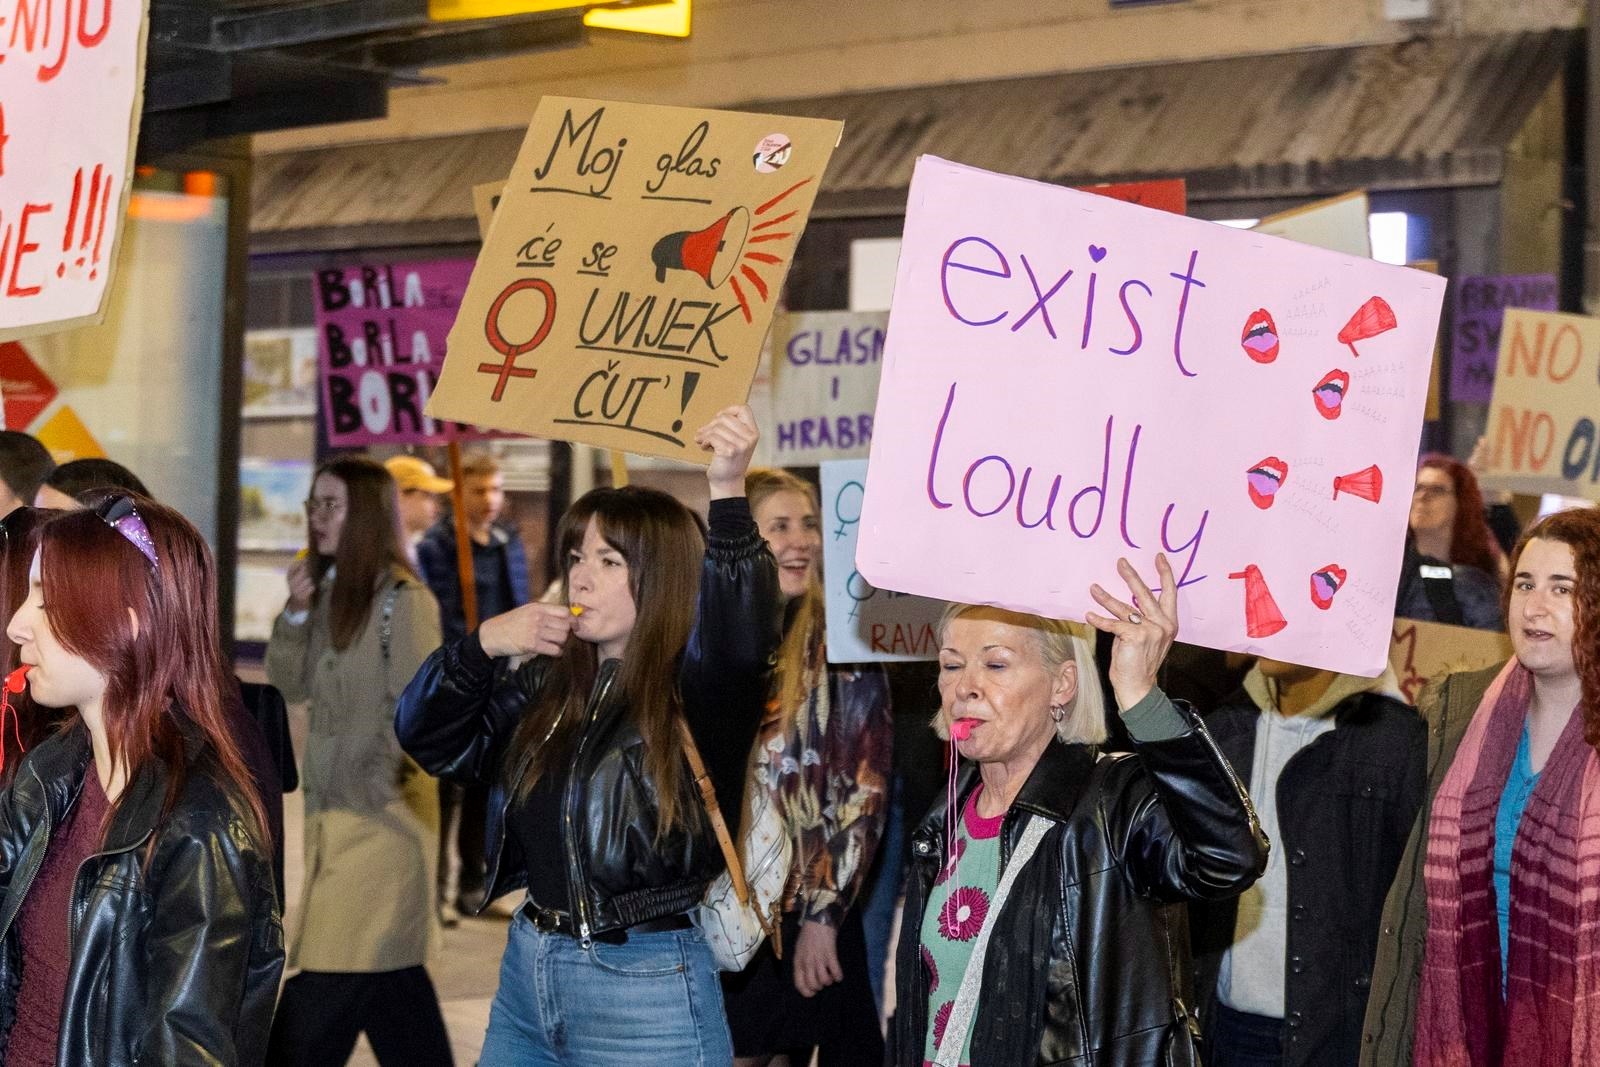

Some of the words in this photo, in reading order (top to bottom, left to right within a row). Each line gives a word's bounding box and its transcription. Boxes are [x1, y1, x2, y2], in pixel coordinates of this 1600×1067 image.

[0, 0, 112, 83] NIJU
[534, 106, 628, 197] Moj
[646, 120, 721, 193] glas
[517, 222, 562, 262] će
[581, 241, 619, 271] se
[579, 287, 743, 361] UVIJEK
[940, 235, 1206, 378] exist
[831, 376, 840, 400] I
[1505, 318, 1584, 384] NO
[1495, 404, 1556, 473] NO
[1562, 418, 1600, 483] O
[926, 382, 1210, 608] loudly
